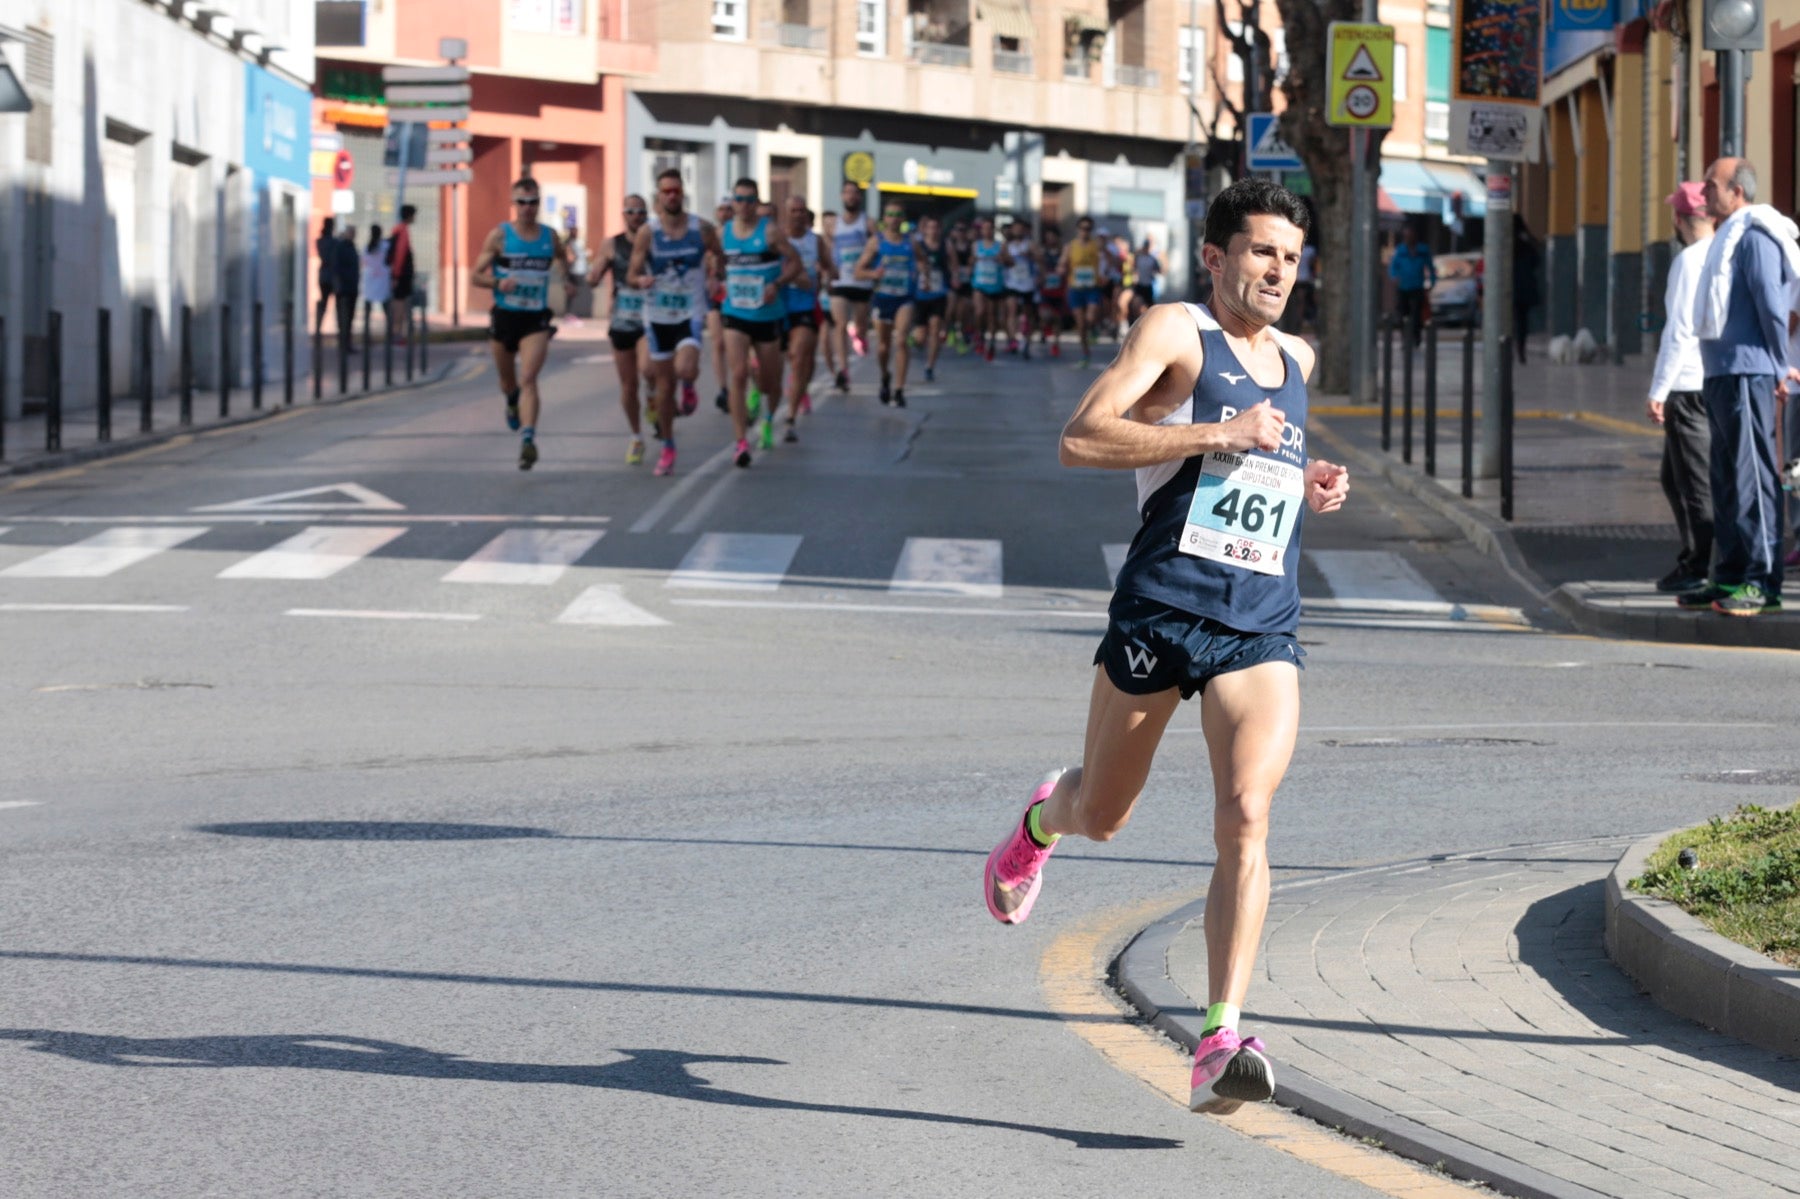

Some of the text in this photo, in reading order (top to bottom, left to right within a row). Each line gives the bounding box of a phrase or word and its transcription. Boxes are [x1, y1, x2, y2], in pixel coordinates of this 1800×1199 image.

[1352, 93, 1372, 109] 20
[1235, 454, 1254, 469] GRAN
[1255, 460, 1281, 476] PREMIO
[1212, 488, 1286, 538] 461
[1124, 645, 1158, 677] W
